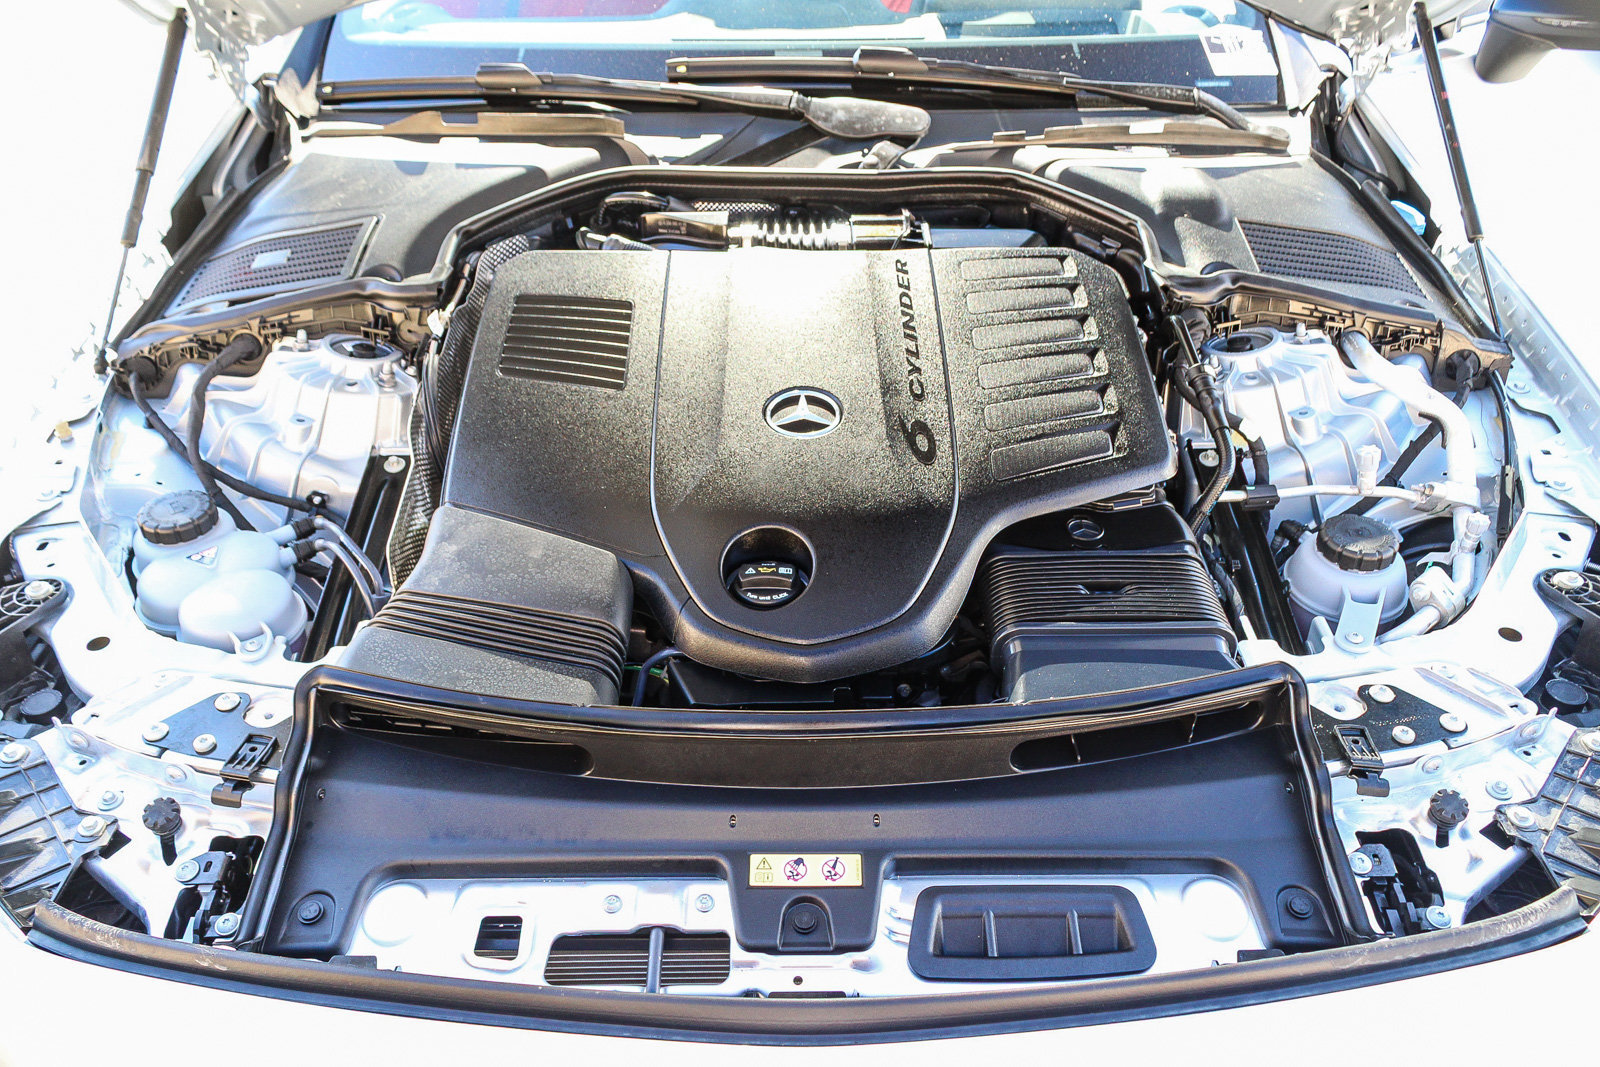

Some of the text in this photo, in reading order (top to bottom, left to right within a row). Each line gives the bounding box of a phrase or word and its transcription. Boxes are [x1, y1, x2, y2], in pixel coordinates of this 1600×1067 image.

[895, 258, 937, 465] 6 CYLINDER
[772, 591, 789, 600] CLICK
